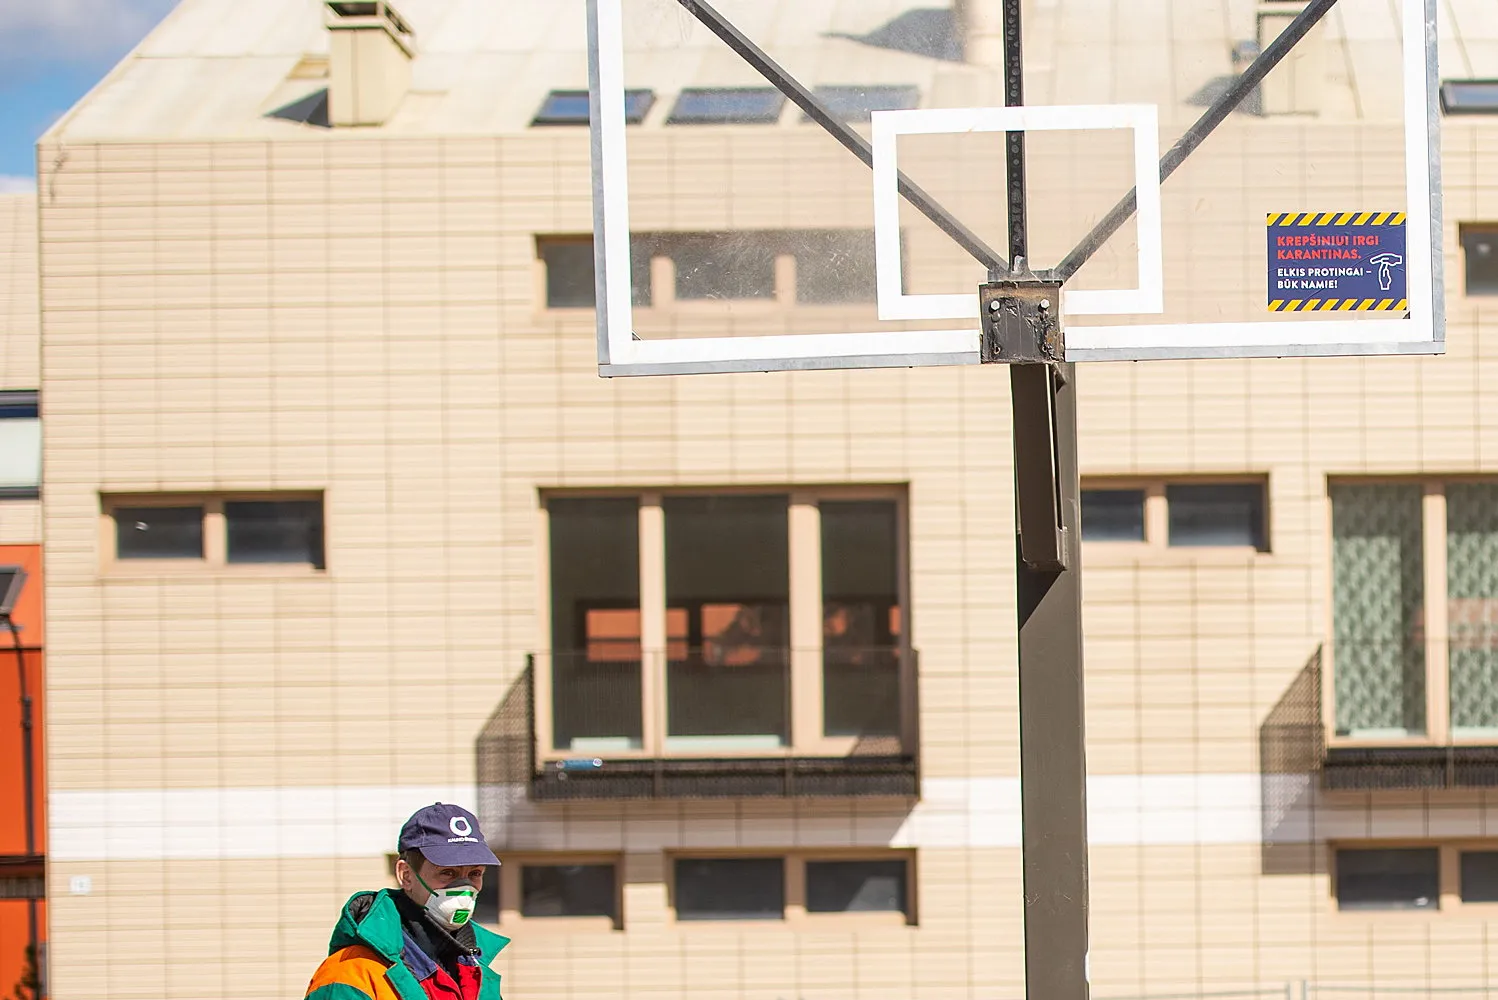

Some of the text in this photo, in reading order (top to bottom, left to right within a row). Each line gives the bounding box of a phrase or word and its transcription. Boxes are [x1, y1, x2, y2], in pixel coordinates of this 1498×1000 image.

[1277, 233, 1379, 246] KREPŠINIUI IRGI
[1277, 249, 1361, 259] KARANTINAS.
[1277, 268, 1306, 277] ELKIS
[1308, 267, 1363, 277] PROTINGAI
[1277, 278, 1338, 289] BŪK NAMIE!
